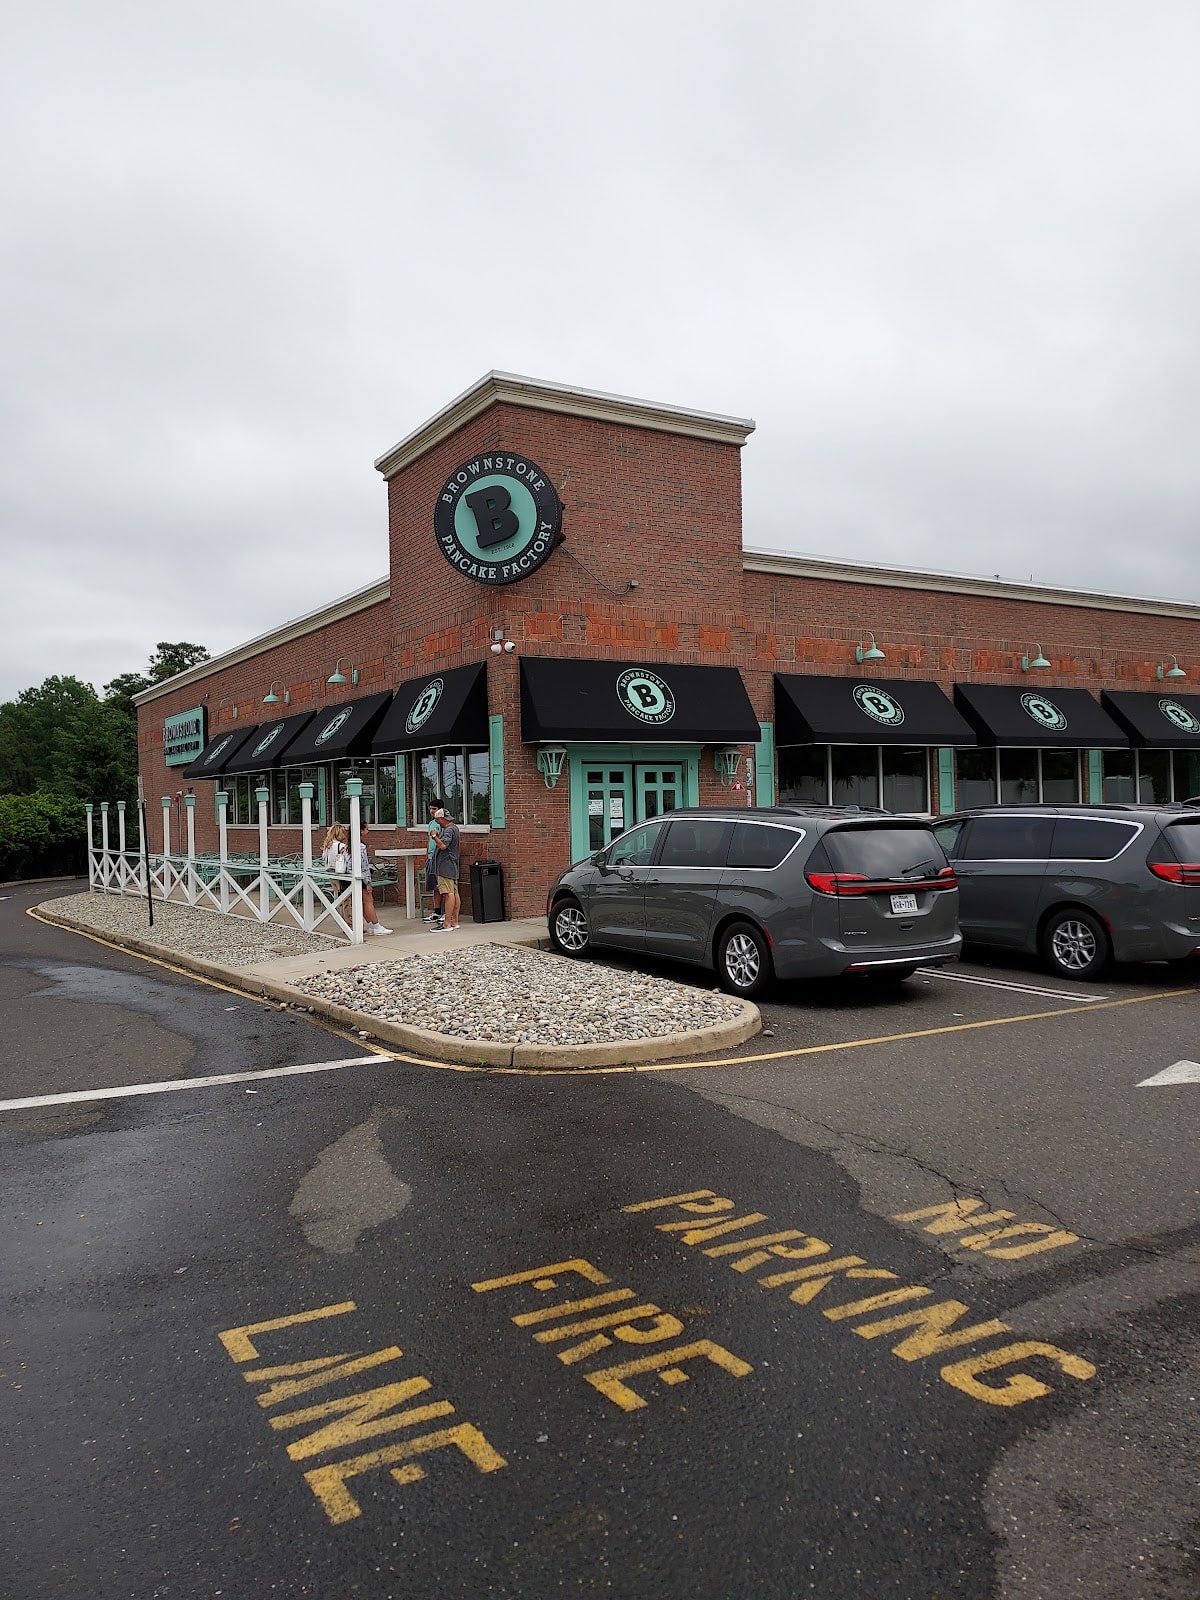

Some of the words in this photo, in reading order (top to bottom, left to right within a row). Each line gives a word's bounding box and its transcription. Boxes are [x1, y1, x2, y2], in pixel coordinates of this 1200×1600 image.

[441, 457, 546, 504] BROWNSTONE
[464, 485, 520, 549] B
[442, 534, 497, 579] PANCAKE
[502, 521, 552, 577] FACTORY
[620, 672, 665, 689] BROWNSTONE
[631, 684, 658, 708] B
[866, 696, 889, 713] B
[624, 699, 654, 721] PANCAKE
[655, 699, 673, 721] FACTORY
[1032, 703, 1053, 719] B
[899, 1199, 1079, 1260] NO
[621, 1189, 1096, 1407] PARKING
[472, 1258, 754, 1411] FIRE
[218, 1300, 508, 1525] LANE
